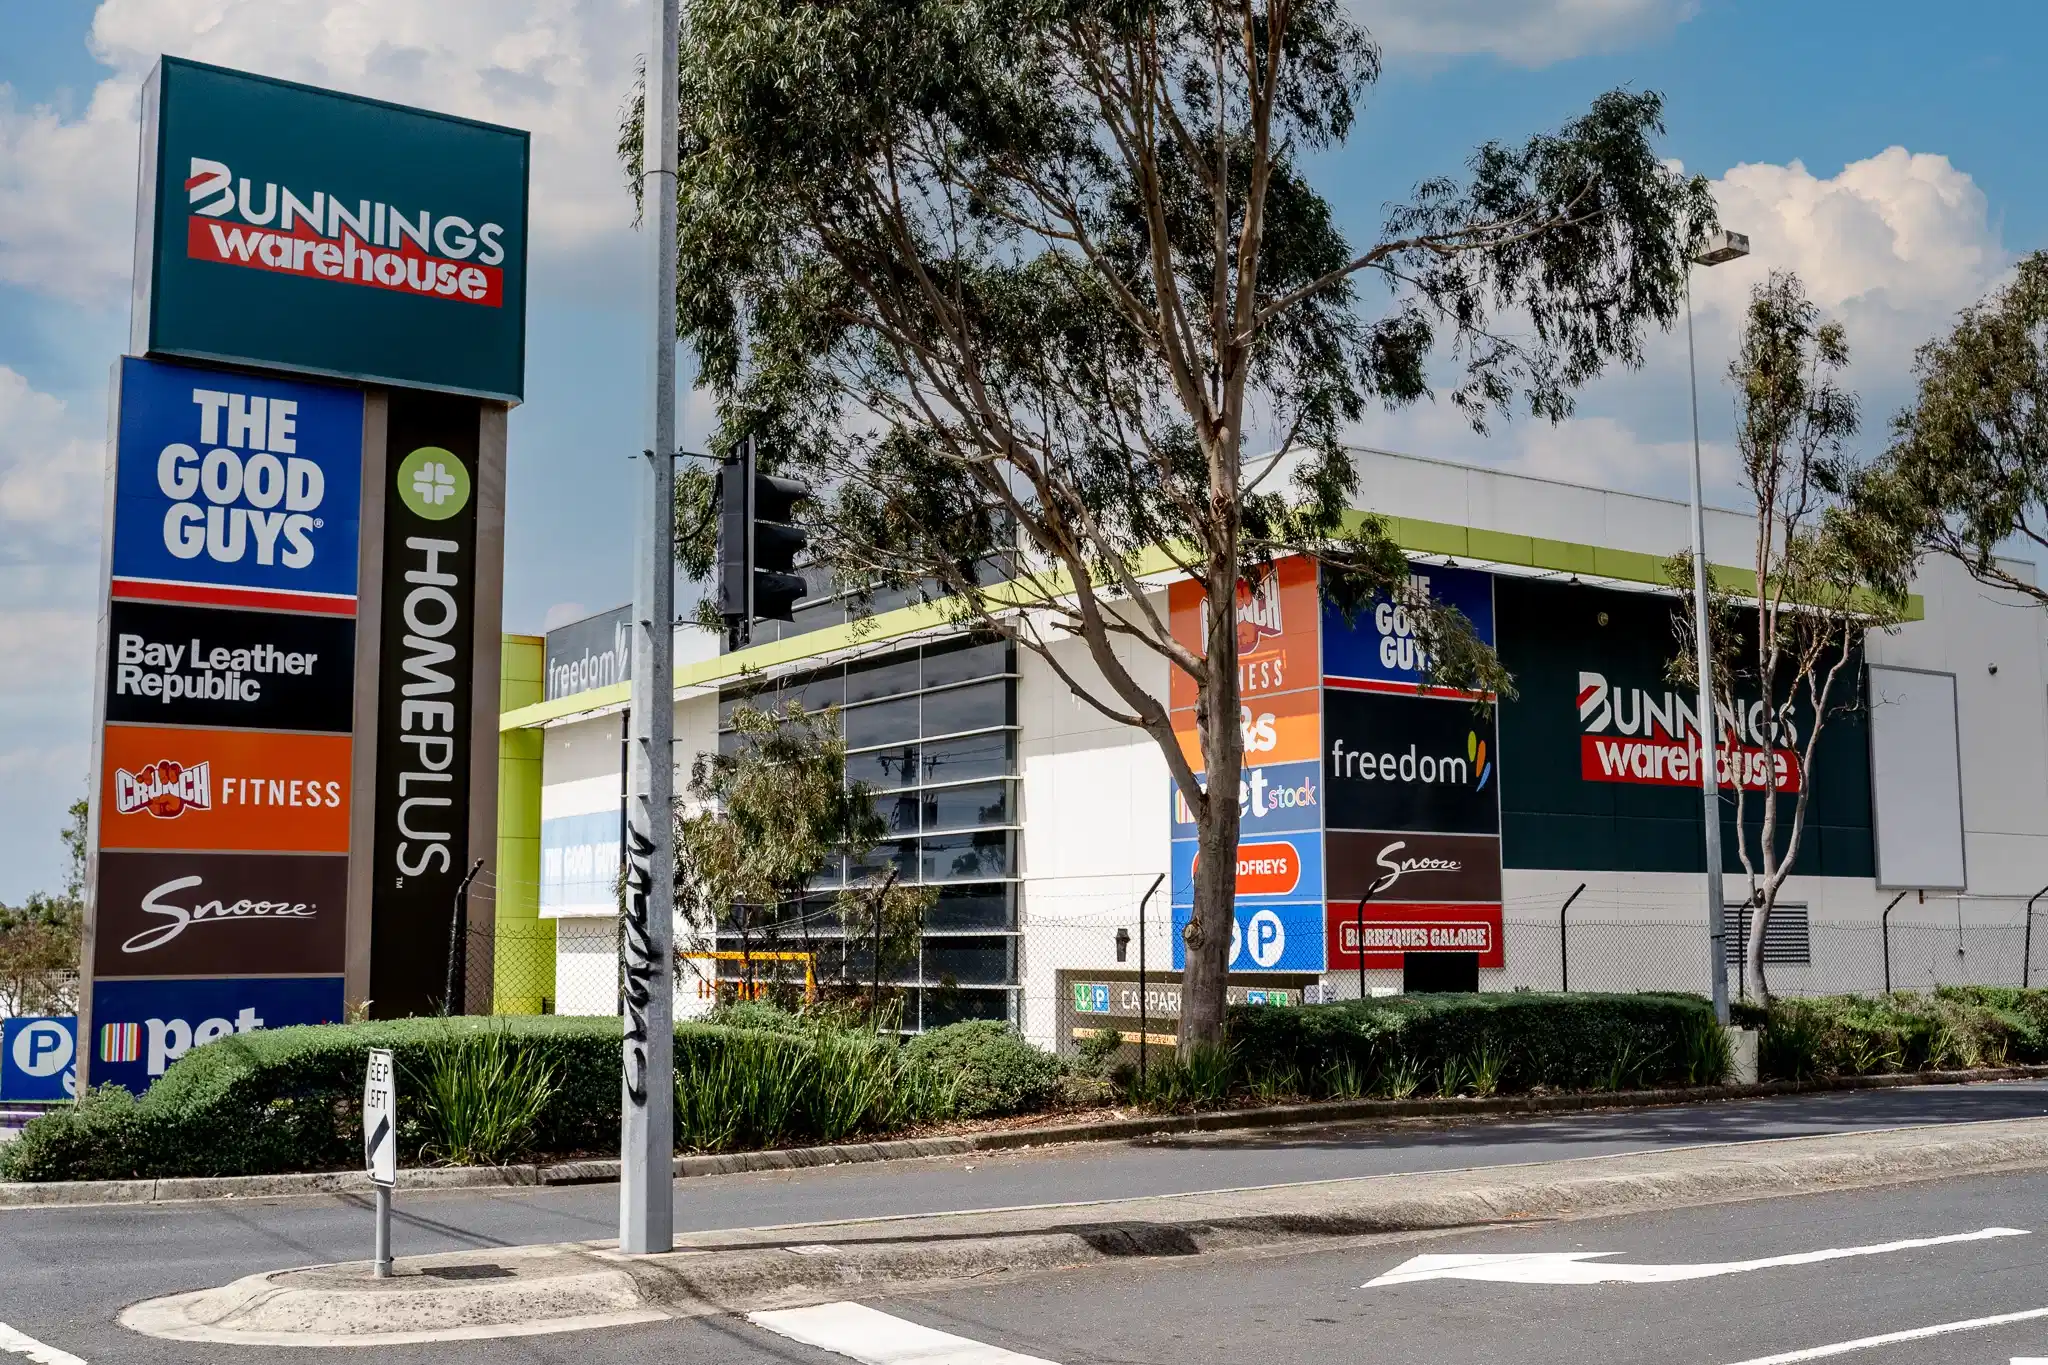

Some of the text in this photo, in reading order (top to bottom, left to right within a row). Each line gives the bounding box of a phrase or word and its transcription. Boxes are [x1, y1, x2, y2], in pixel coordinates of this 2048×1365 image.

[185, 157, 505, 266] BUNNINGS
[193, 388, 298, 454] THE
[157, 443, 325, 512] GOOD
[1391, 574, 1431, 606] HE
[118, 633, 318, 676] Bay Leather
[548, 648, 615, 701] freedom
[1238, 659, 1283, 692] NESS
[1380, 635, 1441, 672] GUY
[116, 665, 261, 704] Republic
[396, 536, 459, 877] HOMEPLUS
[1576, 671, 1799, 749] BUNNNGS
[1332, 739, 1468, 784] freedom
[116, 760, 341, 815] CRUNCH FITNESS
[1268, 776, 1317, 810] stock
[1236, 857, 1288, 876] DFREYS
[1368, 841, 1462, 893] Snooze
[121, 875, 317, 953] Snooze
[1257, 920, 1277, 958] P
[1430, 928, 1487, 947] GALORE
[29, 1030, 62, 1068] P
